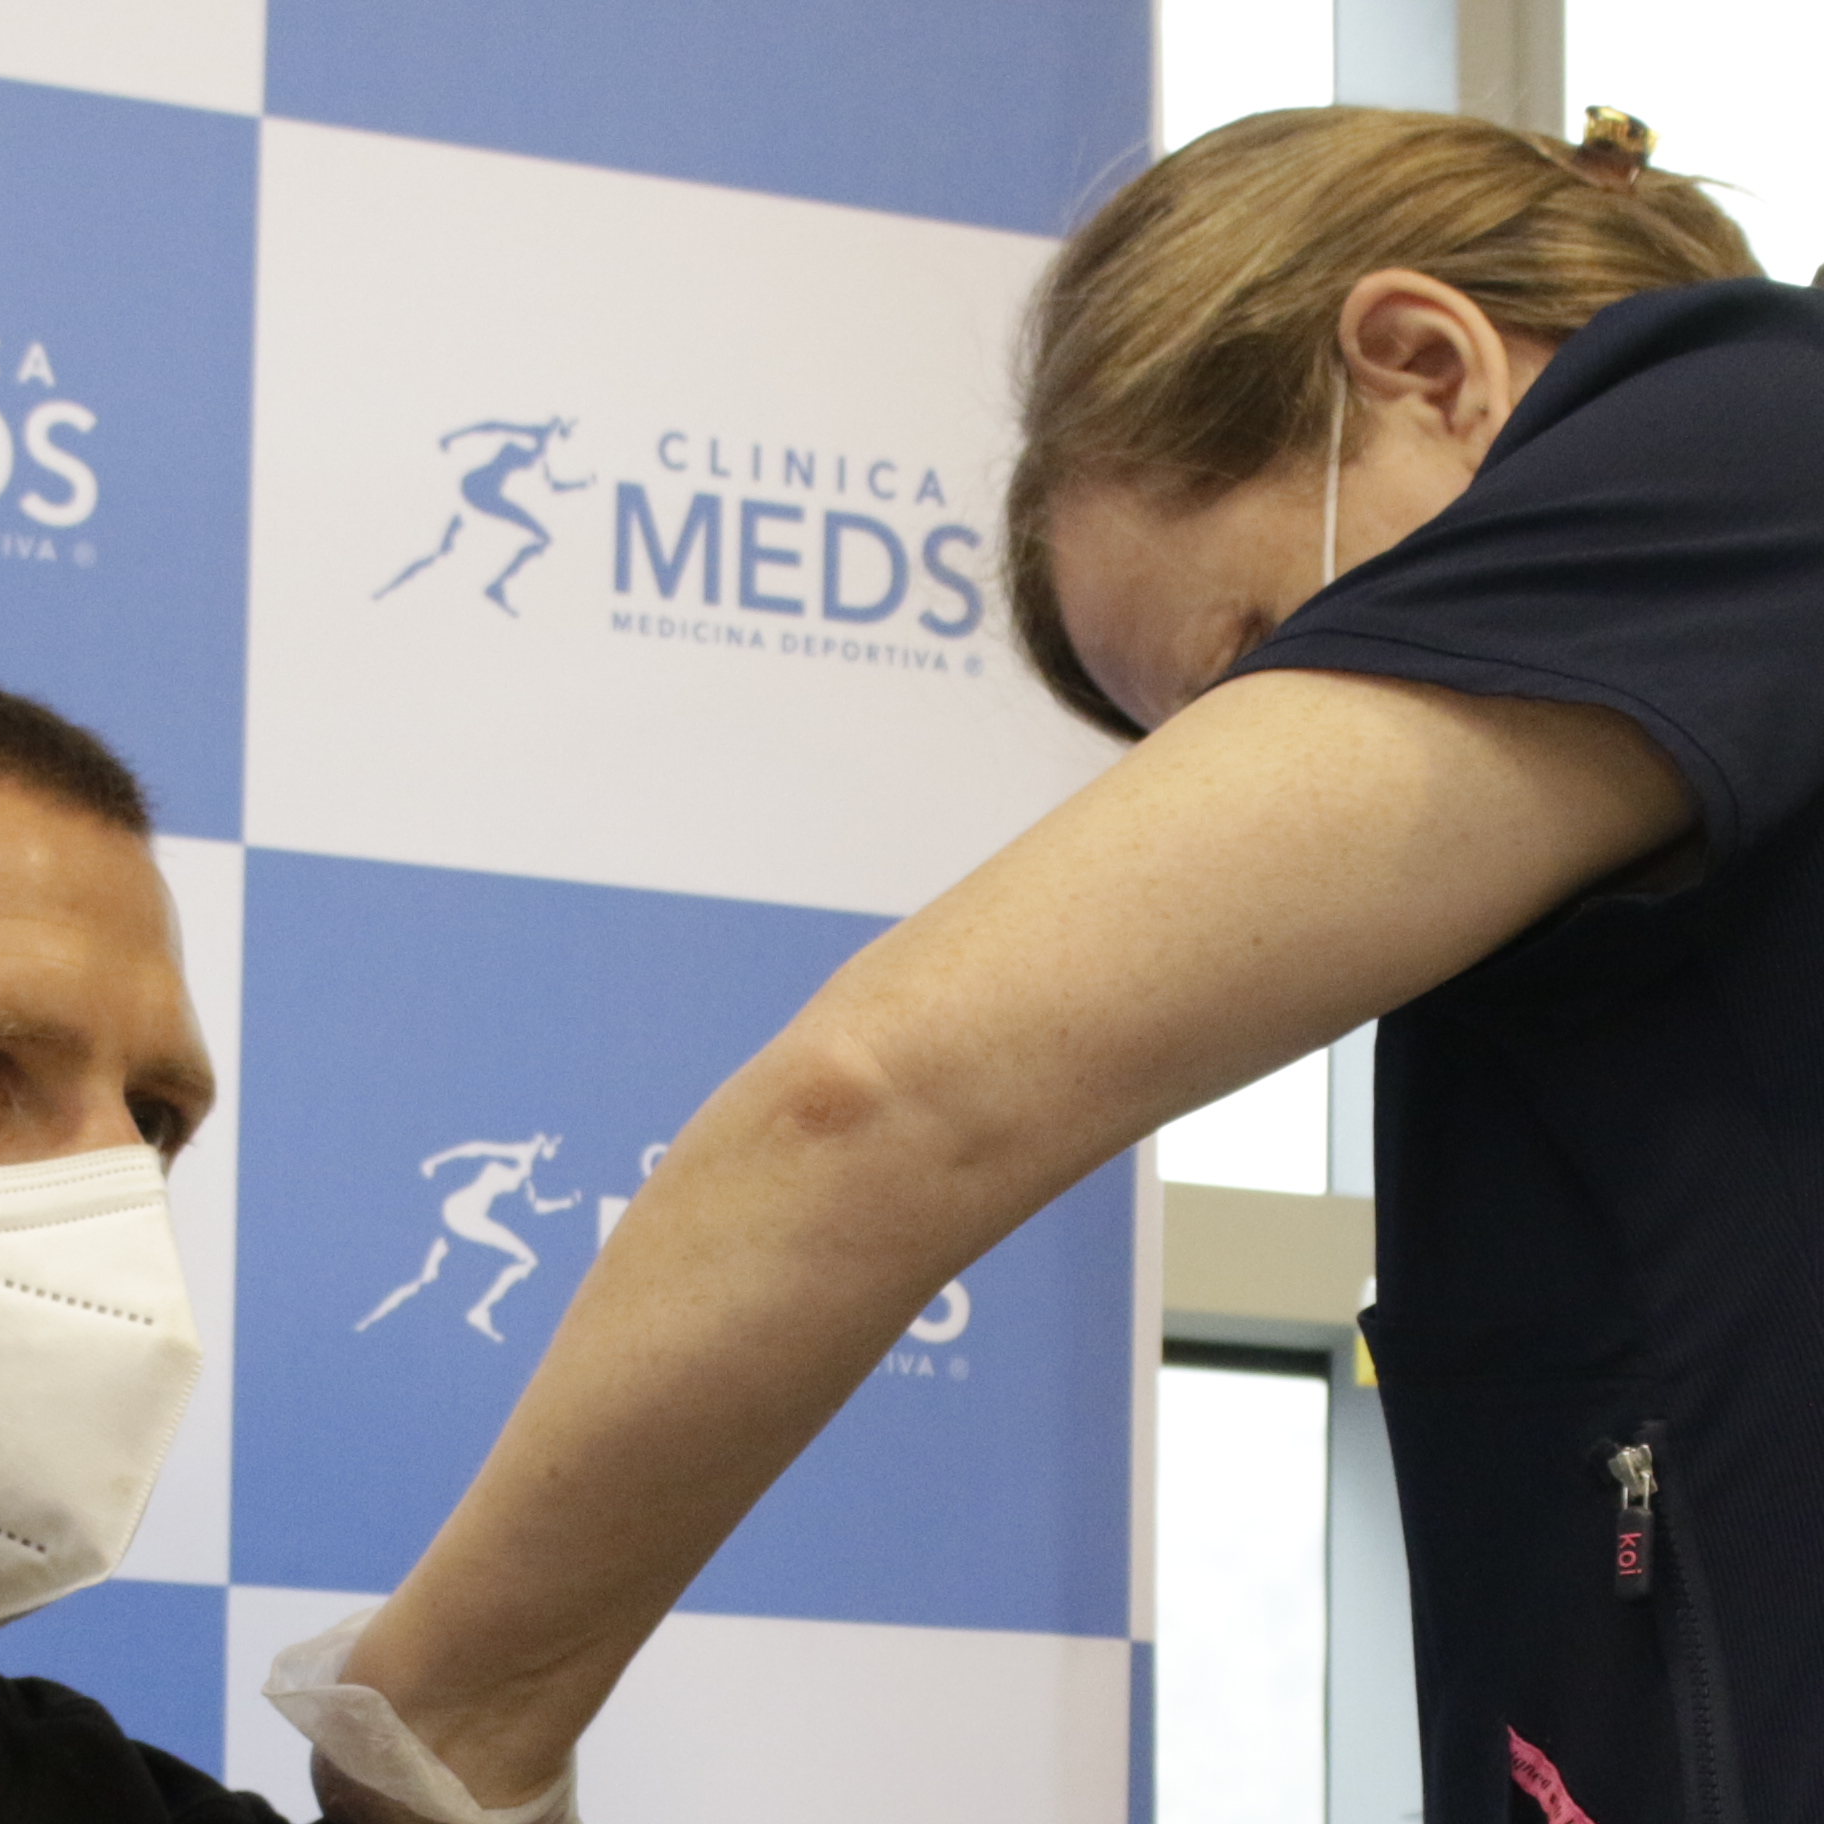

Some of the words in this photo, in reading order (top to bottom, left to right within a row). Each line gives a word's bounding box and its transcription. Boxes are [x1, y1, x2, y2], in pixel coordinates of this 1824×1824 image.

[658, 431, 945, 506] CLINICA
[615, 483, 984, 638] MEDS
[611, 612, 764, 647] MEDICINA
[781, 633, 948, 671] DEPORTIVA
[1619, 1532, 1643, 1576] koi
